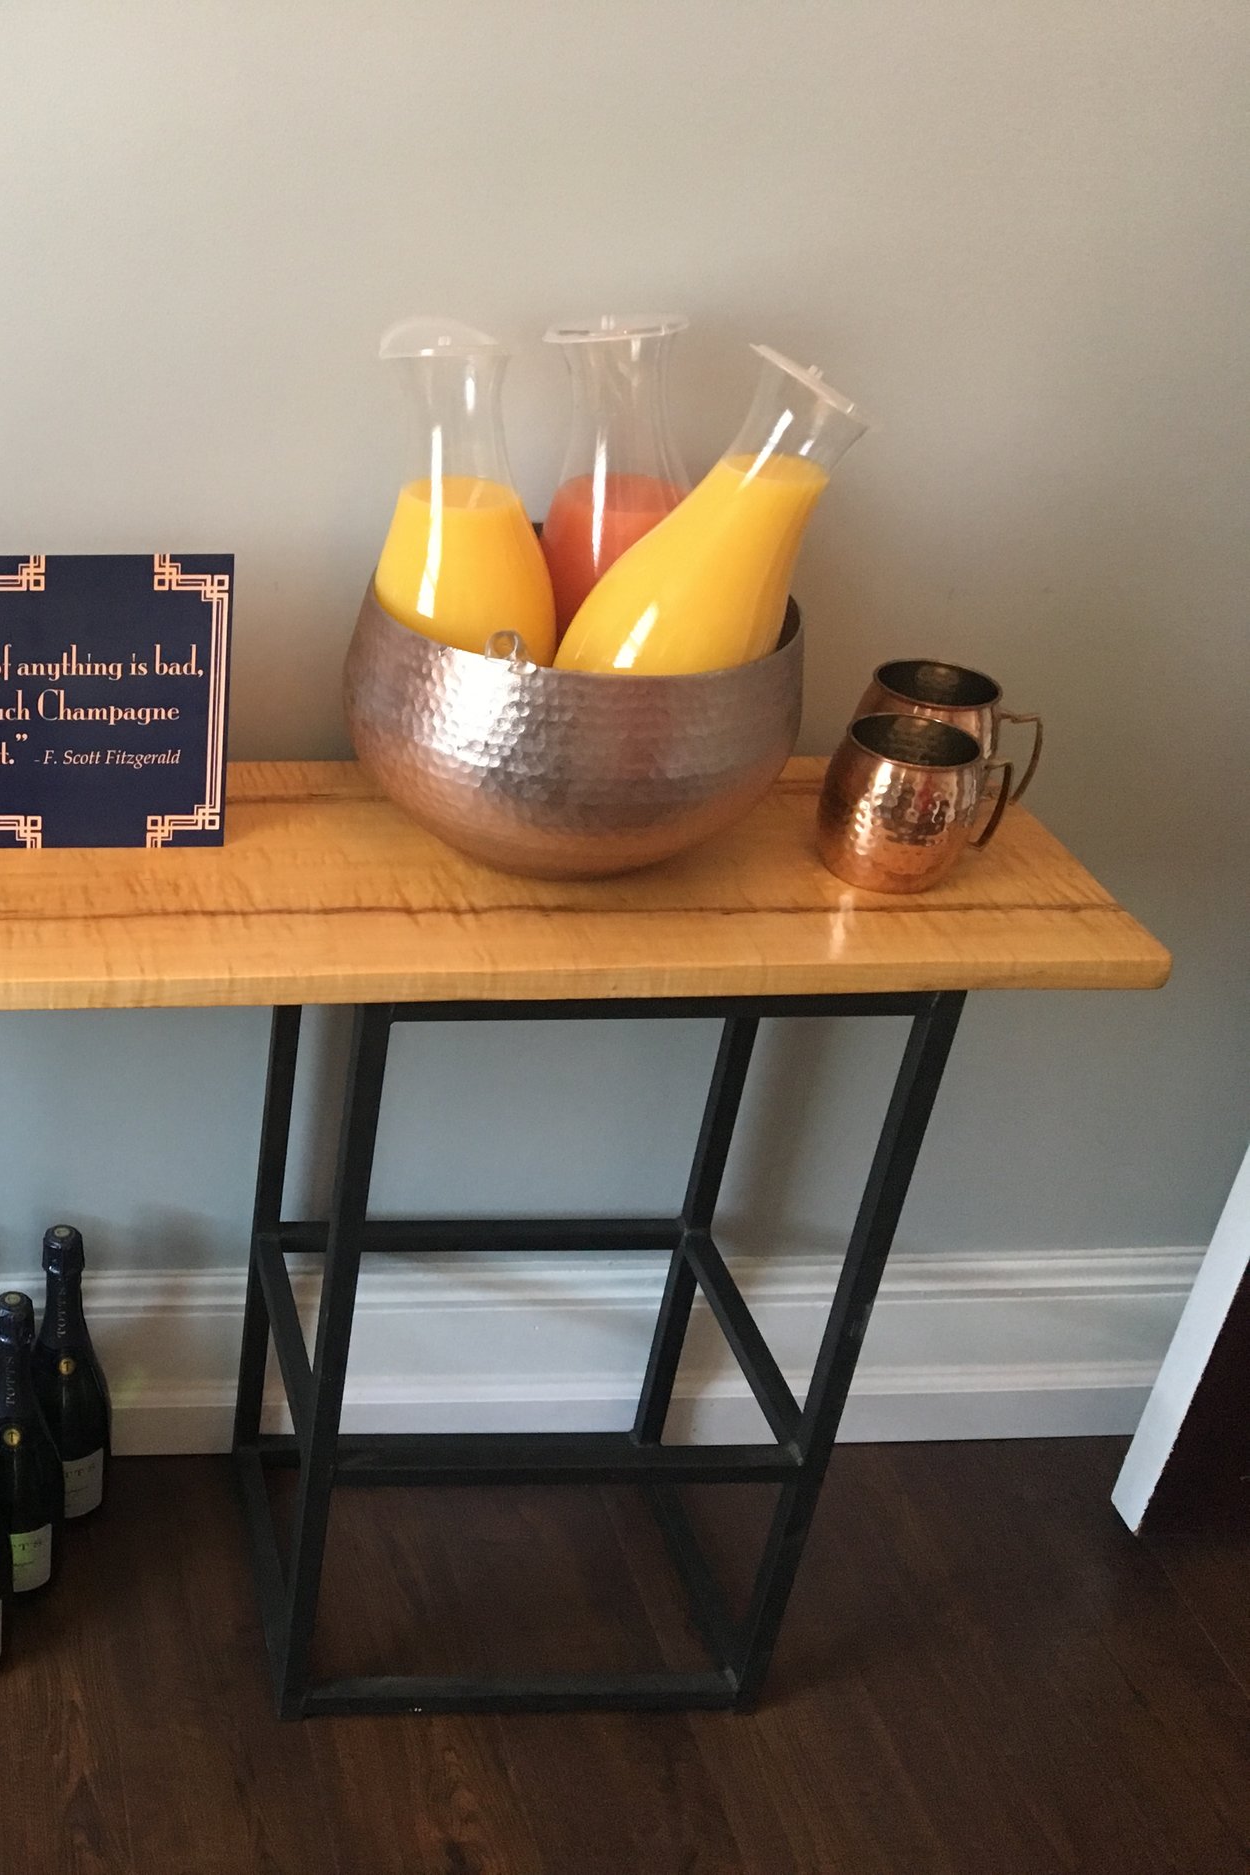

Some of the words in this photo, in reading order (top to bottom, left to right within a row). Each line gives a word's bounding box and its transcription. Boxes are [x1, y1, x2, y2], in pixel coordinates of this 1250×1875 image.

[17, 644, 123, 682] anything
[129, 653, 148, 676] is
[155, 643, 204, 678] bad,
[37, 688, 180, 726] Champagne
[43, 749, 57, 765] F.
[63, 750, 101, 765] Scott
[105, 749, 181, 770] Fitzgerald
